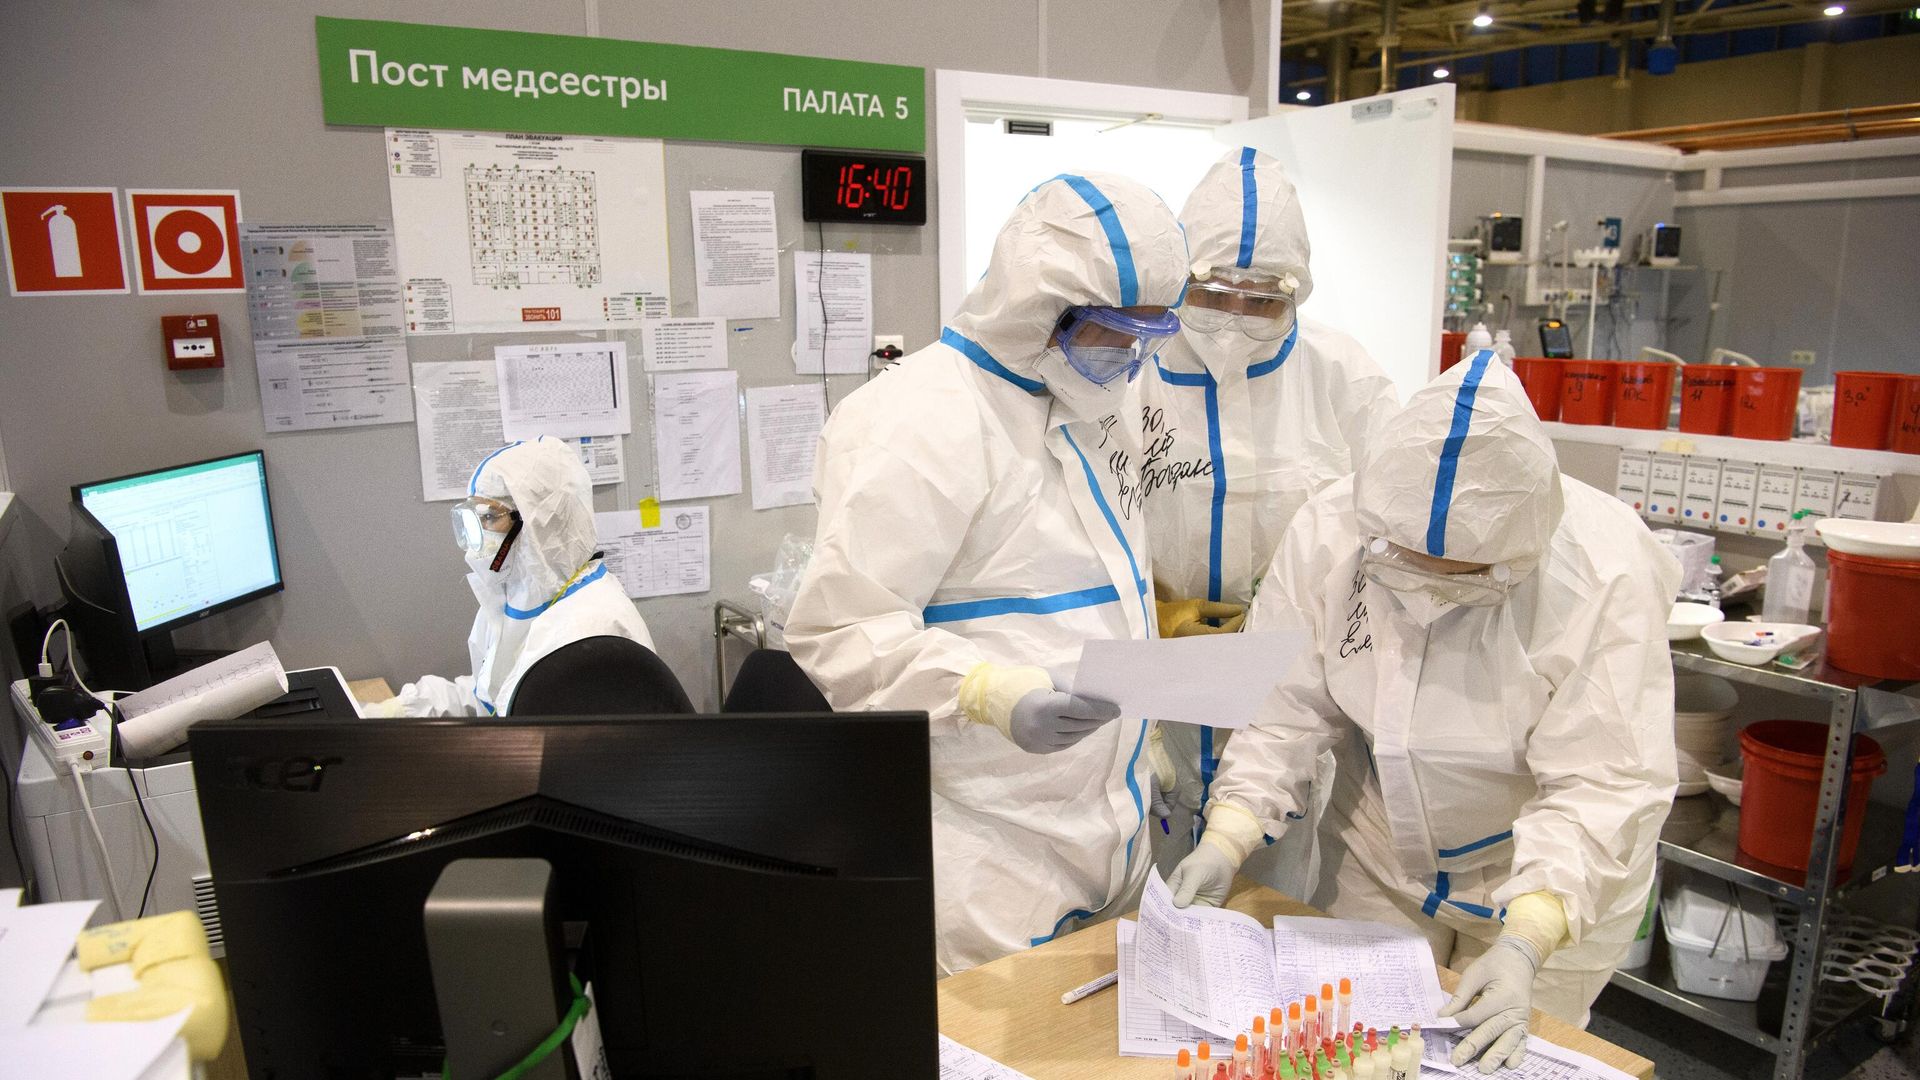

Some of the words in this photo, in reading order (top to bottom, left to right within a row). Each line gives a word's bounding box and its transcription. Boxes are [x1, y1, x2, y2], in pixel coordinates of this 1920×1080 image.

[349, 49, 449, 88] Пост
[462, 66, 668, 108] медсестры
[783, 87, 885, 118] ПАЛАТА
[895, 96, 909, 119] 5
[836, 163, 912, 210] 16:40
[546, 309, 560, 320] 101
